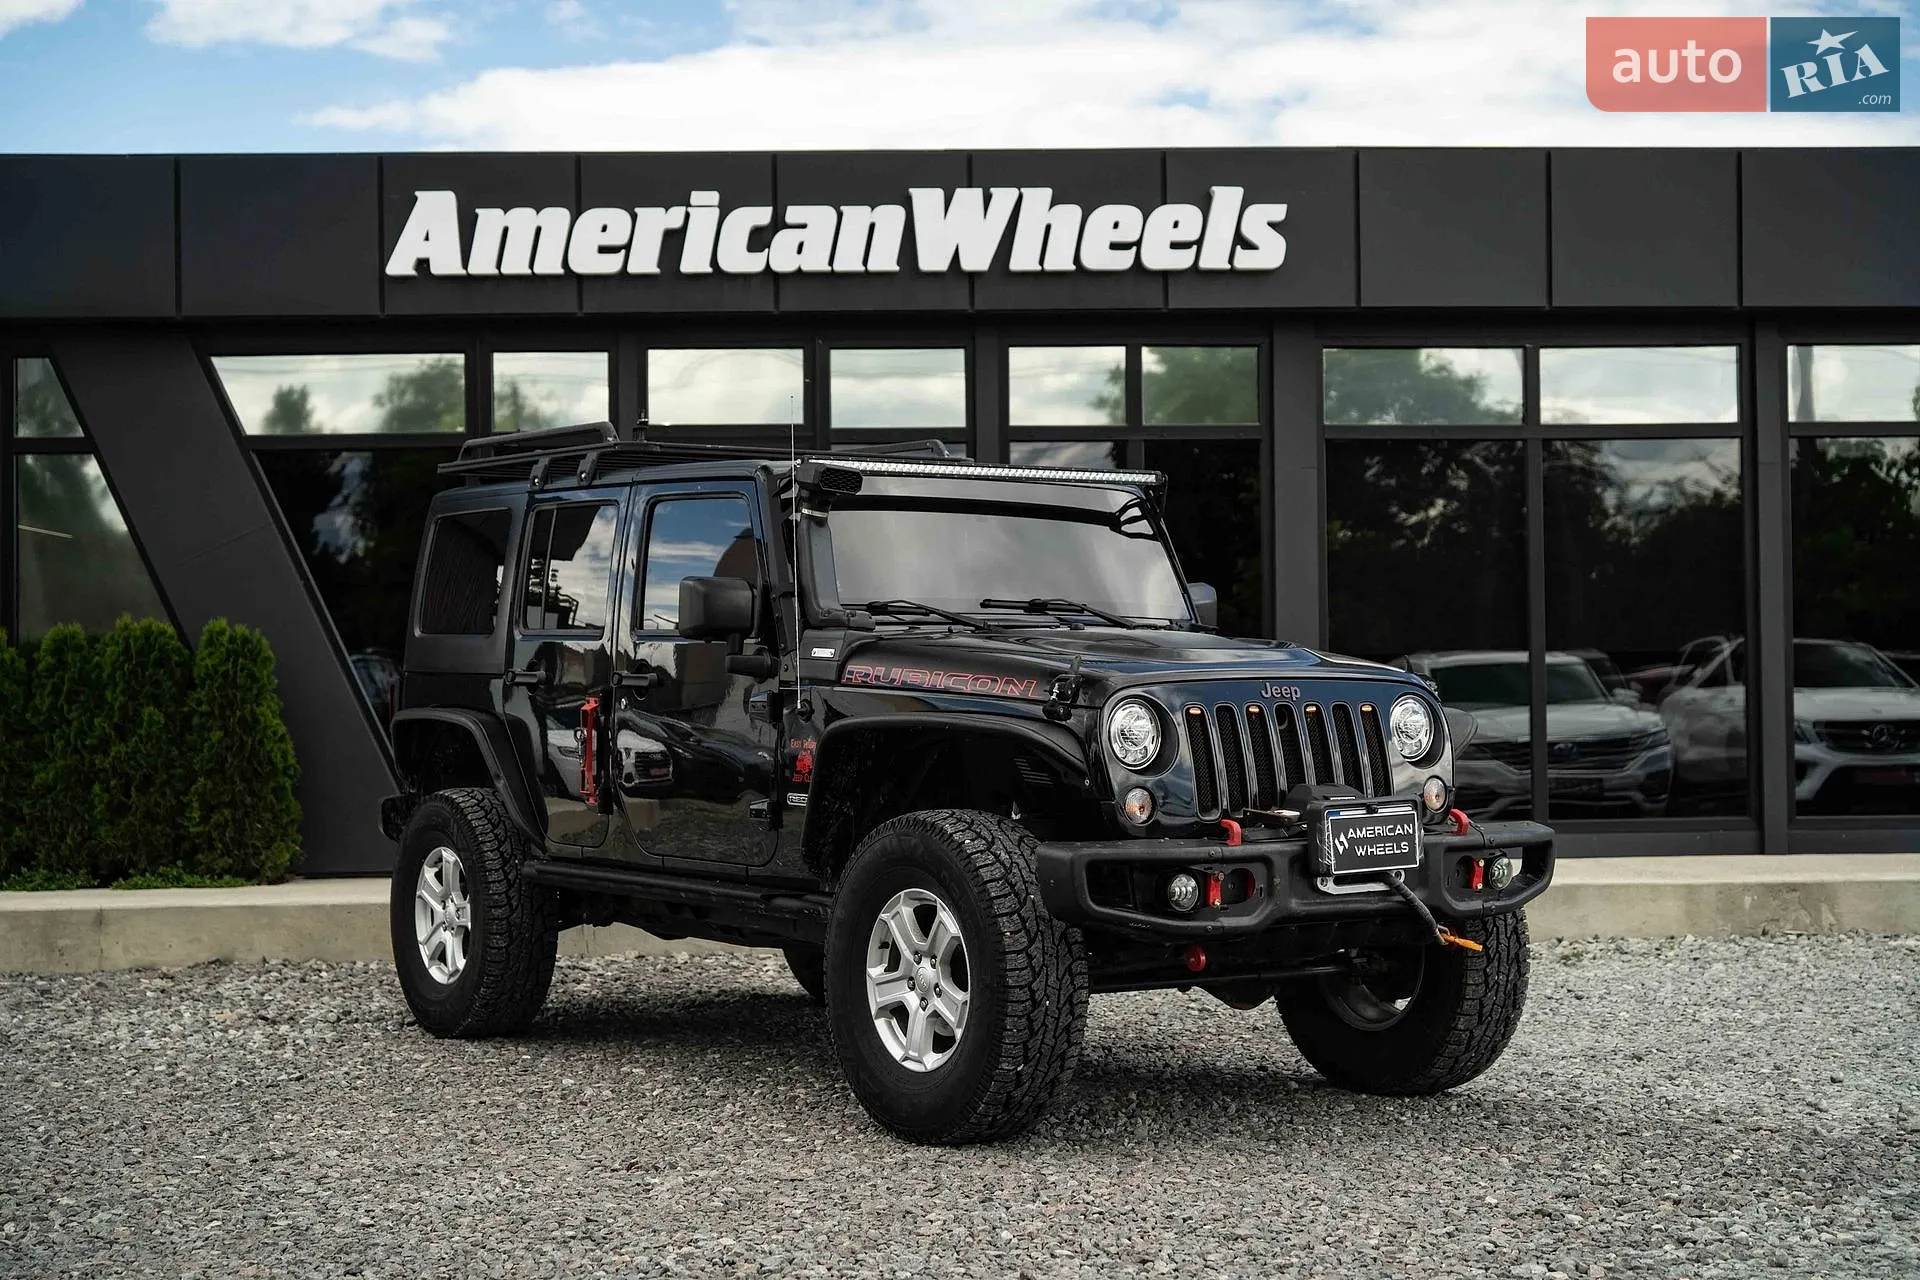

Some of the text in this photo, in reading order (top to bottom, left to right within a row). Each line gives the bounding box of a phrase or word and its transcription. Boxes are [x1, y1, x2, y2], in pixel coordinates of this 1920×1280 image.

[385, 185, 1288, 279] AmericanWheels
[840, 664, 1041, 698] RUBICON
[1260, 682, 1301, 701] Jeep
[1347, 823, 1413, 840] AMERICAN
[1354, 841, 1409, 857] WHEELS
